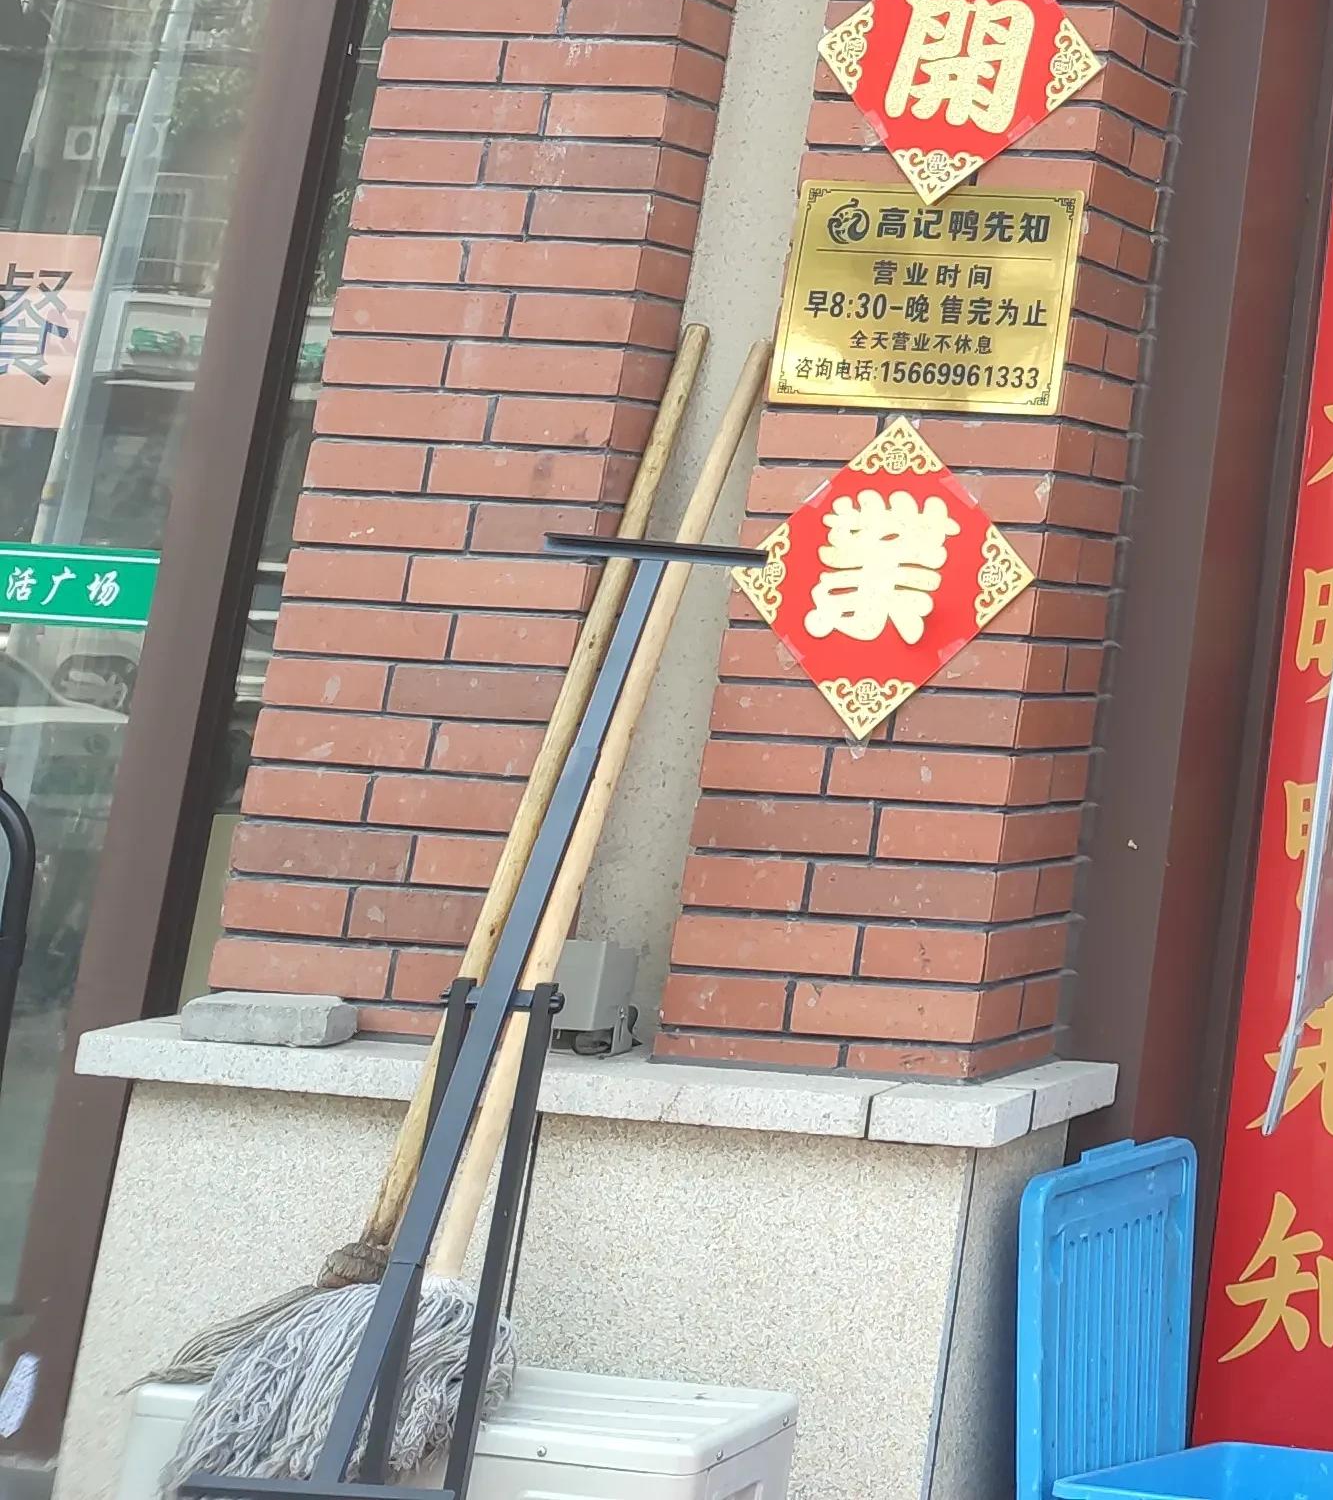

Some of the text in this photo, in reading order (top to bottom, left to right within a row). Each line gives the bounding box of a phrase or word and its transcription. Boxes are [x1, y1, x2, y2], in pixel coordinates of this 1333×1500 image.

[876, 207, 1051, 244] 高记鸭先知
[873, 260, 993, 289] 营业时间
[0, 263, 72, 385] 餐
[804, 290, 1048, 328] 早8:30-晚 售完为止
[849, 330, 994, 355] 全天营业不休息
[795, 358, 1039, 389] 咨询电话:15669961333
[6, 565, 120, 607] 活广场
